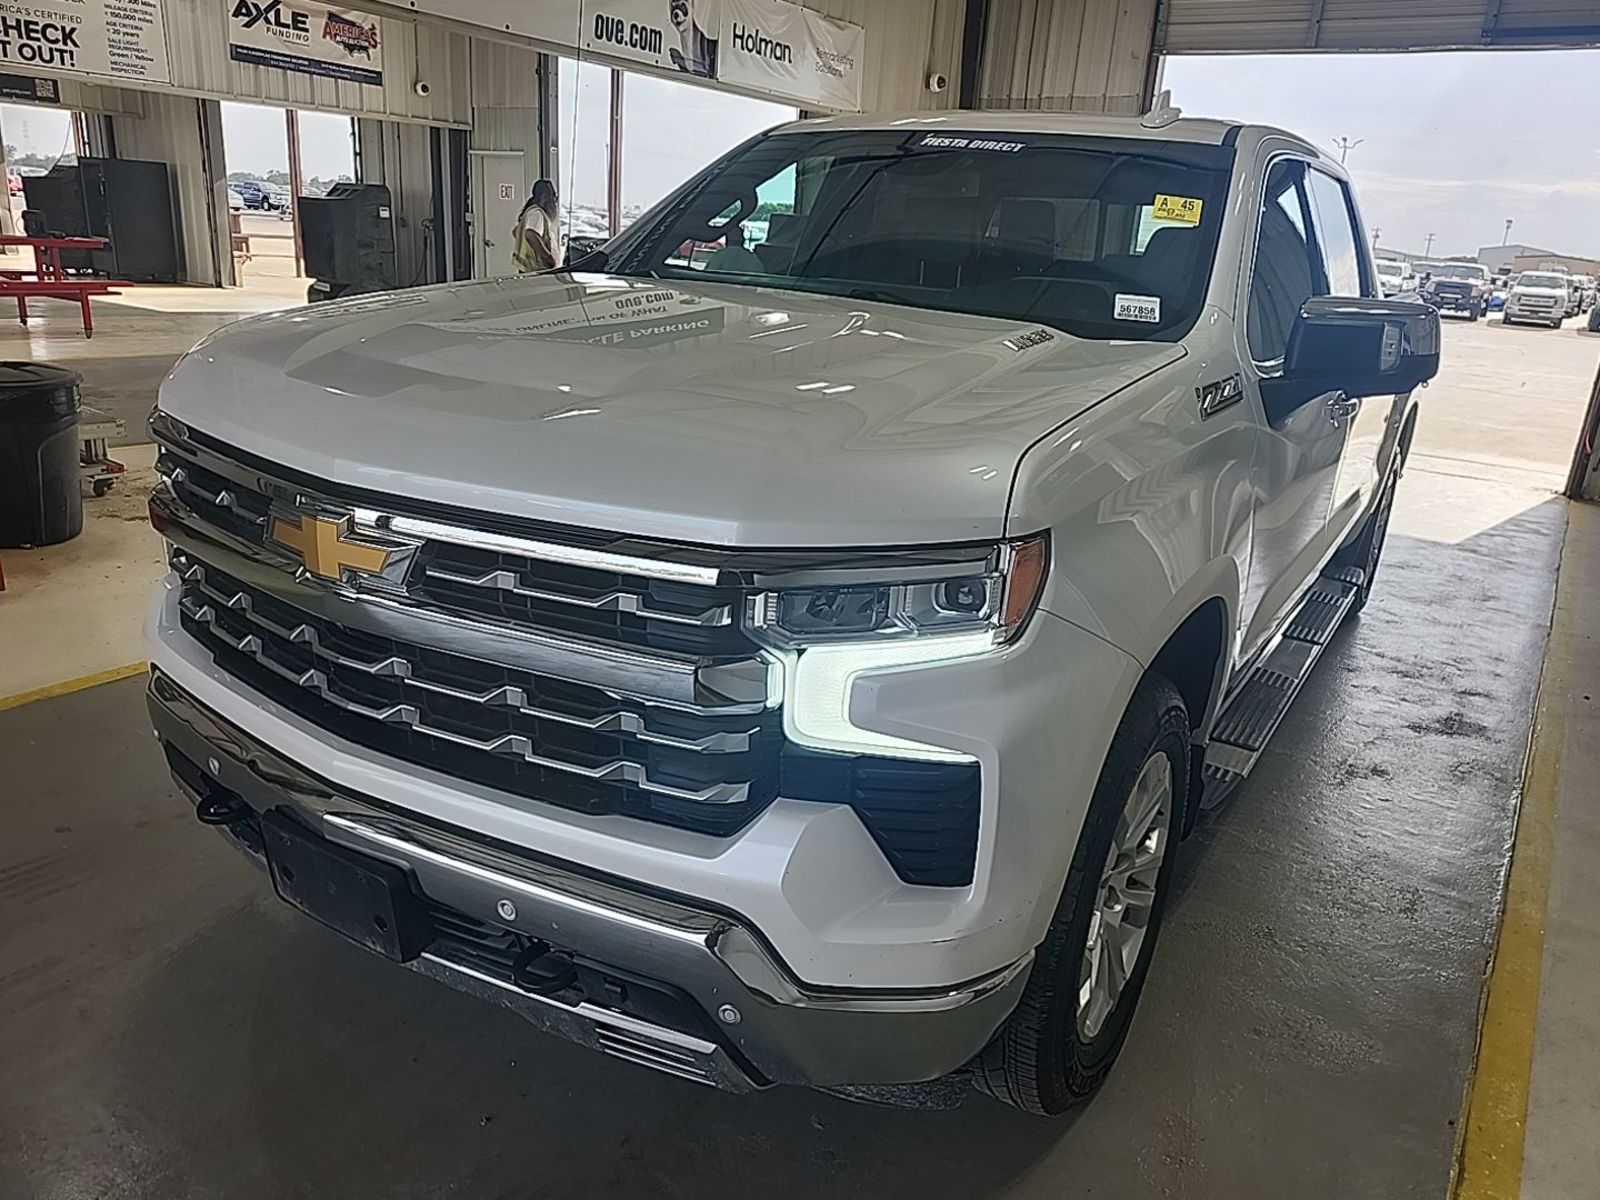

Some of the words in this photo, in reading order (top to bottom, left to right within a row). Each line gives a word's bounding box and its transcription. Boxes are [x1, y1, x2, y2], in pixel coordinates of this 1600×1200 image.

[34, 9, 82, 24] CERTIFIED
[110, 11, 136, 21] 150,000
[232, 0, 310, 33] AXLE
[0, 16, 80, 49] HECK
[266, 26, 310, 42] FUNDING
[594, 13, 662, 55] ove.com
[732, 22, 793, 64] Holman
[18, 43, 75, 67] OUT!
[109, 50, 129, 59] Green
[134, 54, 154, 62] Yellow
[111, 67, 145, 75] INSPECTION
[920, 137, 970, 147] FIESTA
[968, 139, 1026, 152] DIRECT
[1160, 197, 1168, 208] A
[1181, 199, 1196, 211] 45
